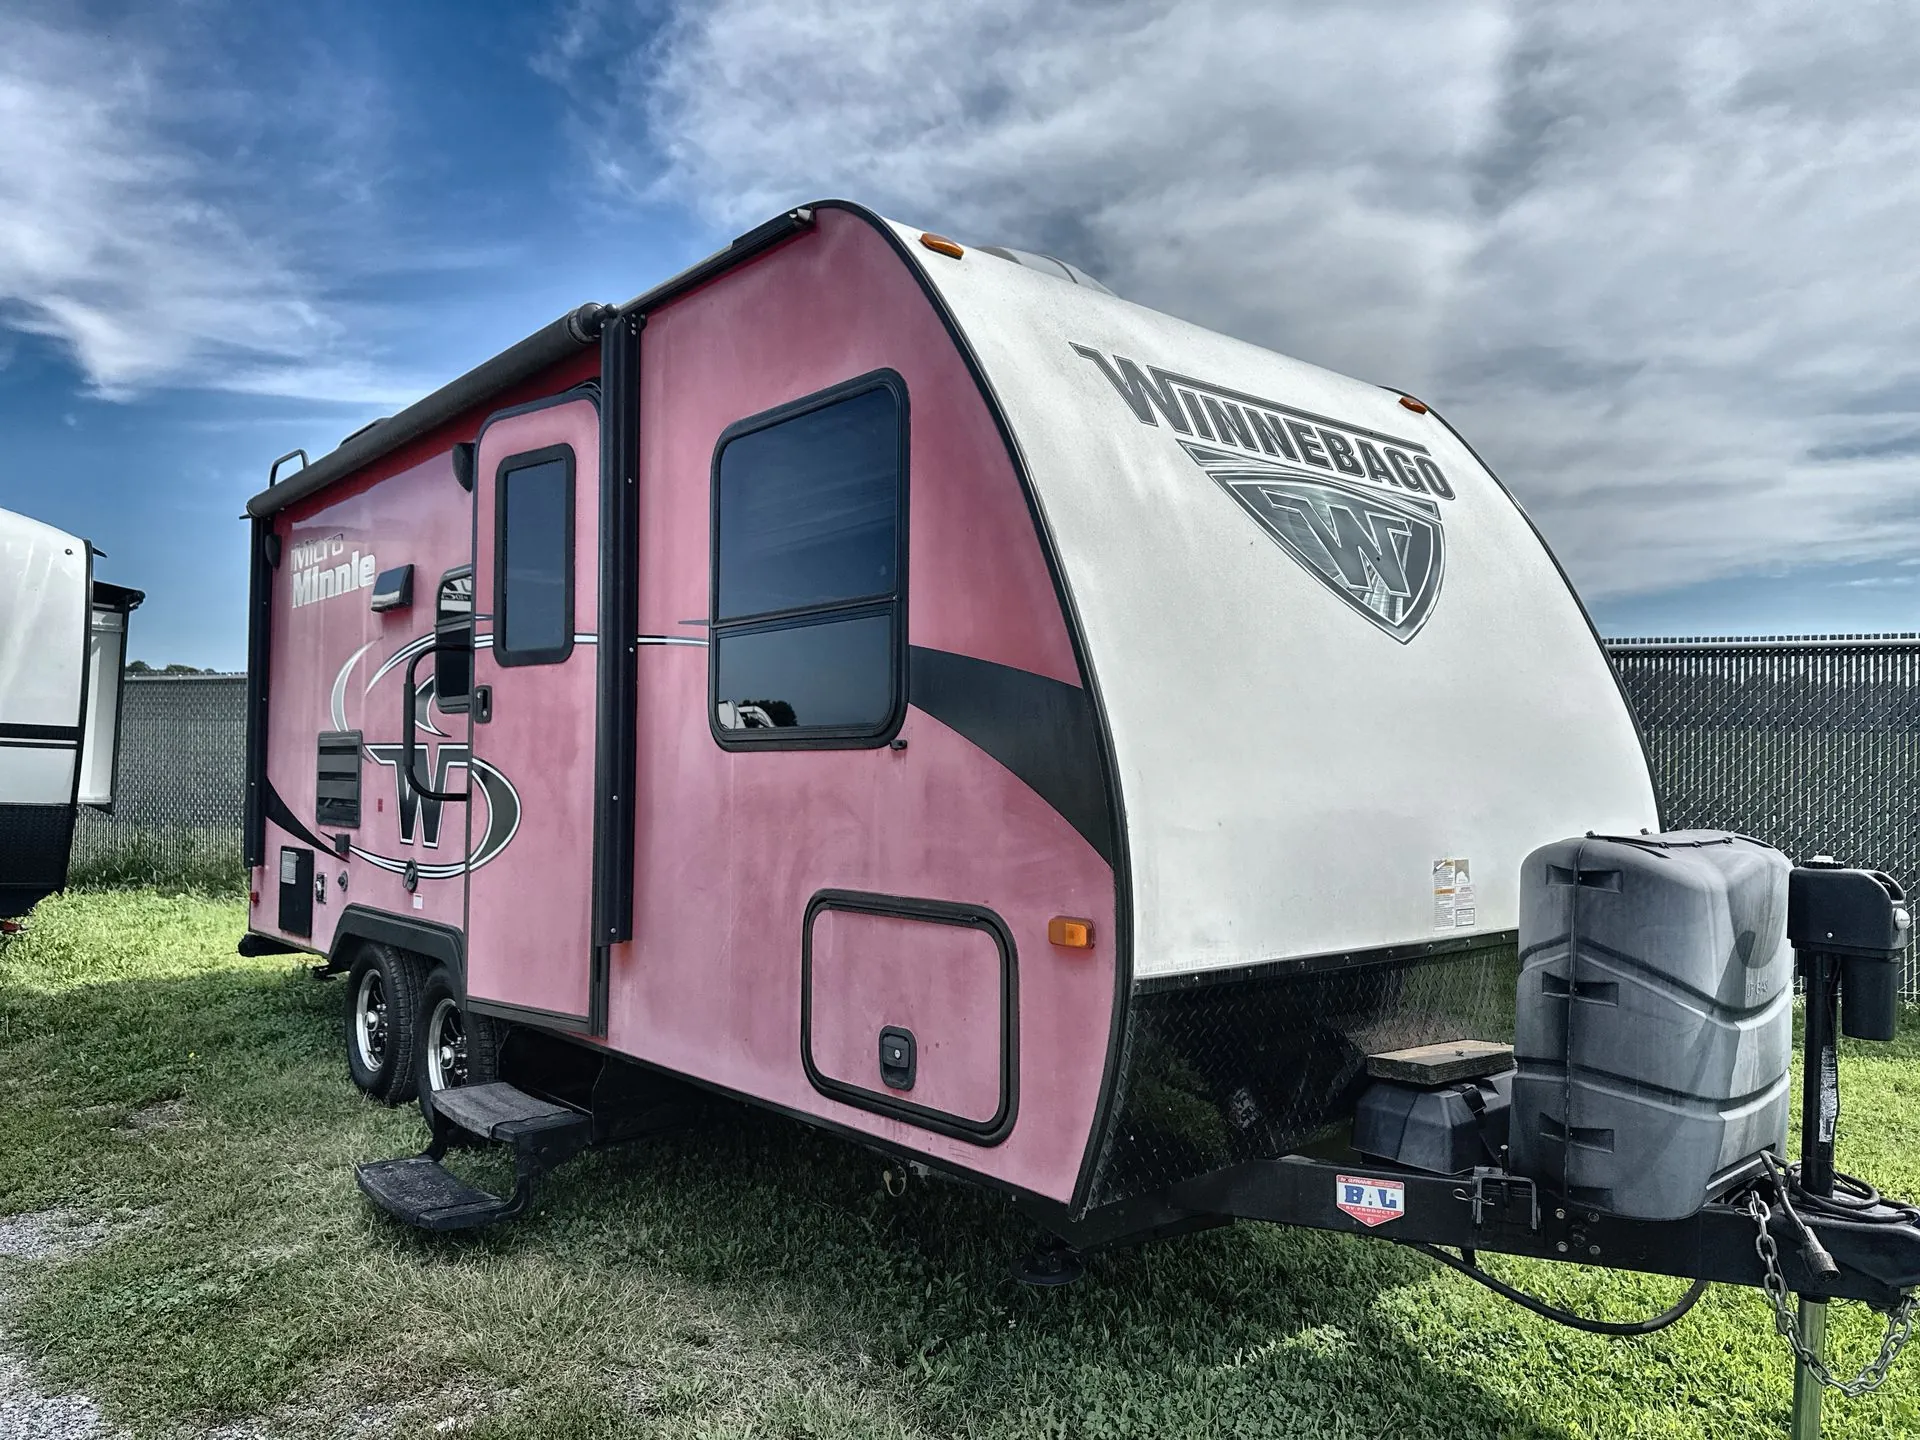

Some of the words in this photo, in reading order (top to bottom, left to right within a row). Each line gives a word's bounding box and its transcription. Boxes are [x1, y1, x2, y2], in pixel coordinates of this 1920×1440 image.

[1068, 341, 1457, 501] WINNEBAGO
[291, 550, 376, 609] Minnie
[1344, 1185, 1397, 1209] BAL
[1356, 1207, 1396, 1216] PRODUCTS
